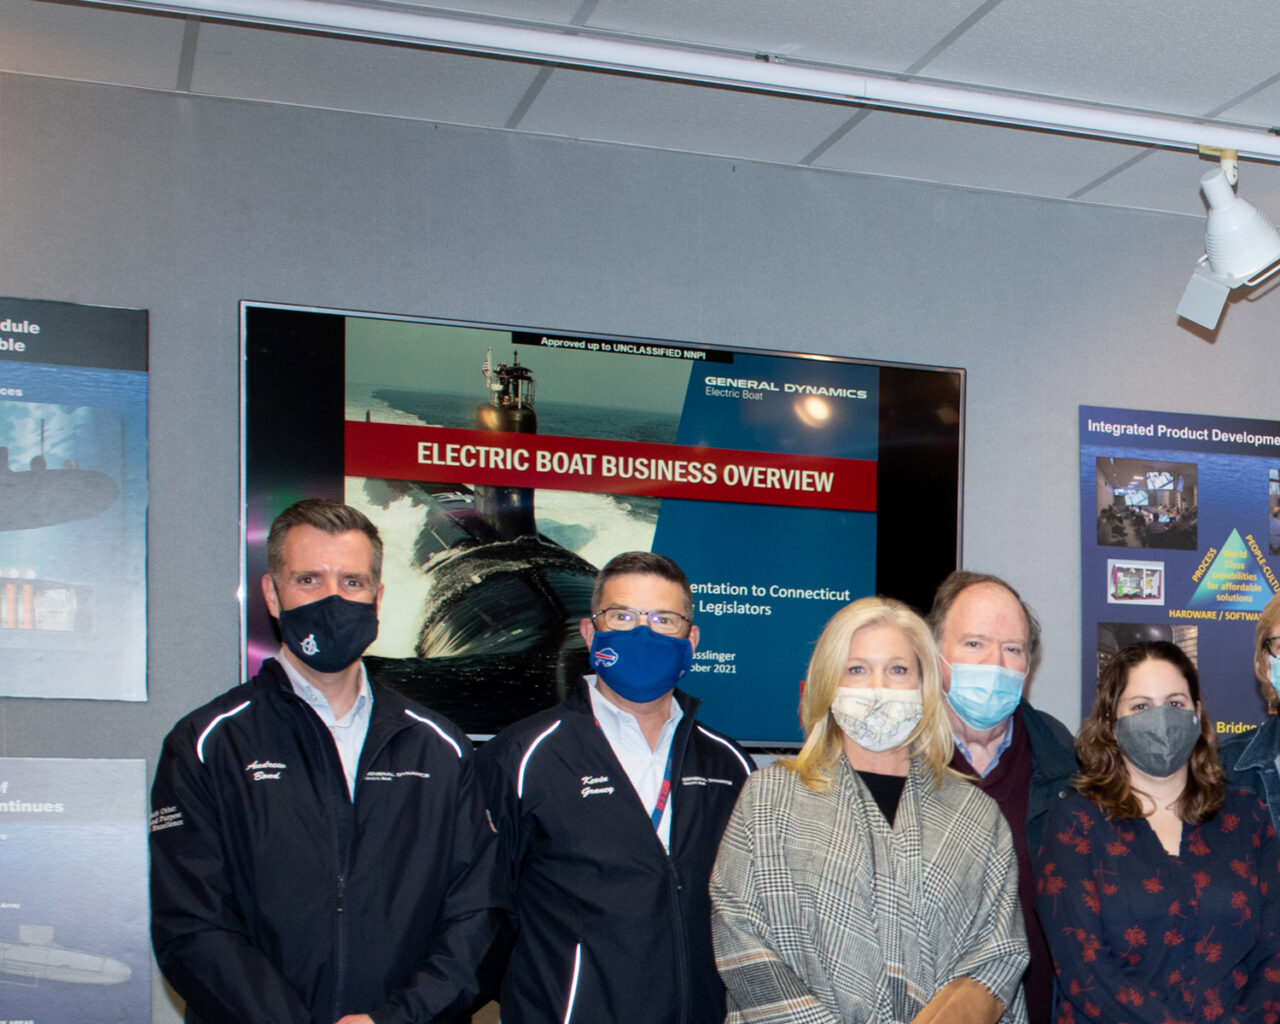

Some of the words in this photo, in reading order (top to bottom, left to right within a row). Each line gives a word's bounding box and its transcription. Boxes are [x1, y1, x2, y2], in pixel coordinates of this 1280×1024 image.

[541, 337, 586, 349] Approved
[588, 342, 599, 351] up
[602, 342, 611, 350] to
[613, 344, 682, 358] UNCLASSIFIED
[705, 376, 780, 391] GENERAL
[784, 383, 868, 399] DYNAMICS
[705, 386, 740, 398] Electric
[743, 390, 763, 400] Boat
[1087, 419, 1154, 437] Integrated
[1157, 424, 1209, 440] Product
[417, 441, 530, 471] ELECTRIC
[536, 450, 596, 476] BOAT
[602, 456, 718, 485] BUSINESS
[723, 464, 835, 493] OVERVIEW
[1192, 547, 1217, 582] PROCESS
[1224, 560, 1245, 570] Class
[1211, 572, 1258, 581] capabilities
[751, 585, 766, 597] to
[769, 585, 851, 601] Connecticut
[1207, 581, 1220, 590] for
[1221, 582, 1262, 592] affordable
[1216, 593, 1253, 602] solutions
[699, 600, 772, 616] Legislators
[1169, 609, 1217, 619] HARDWARE
[714, 664, 736, 674] 2021
